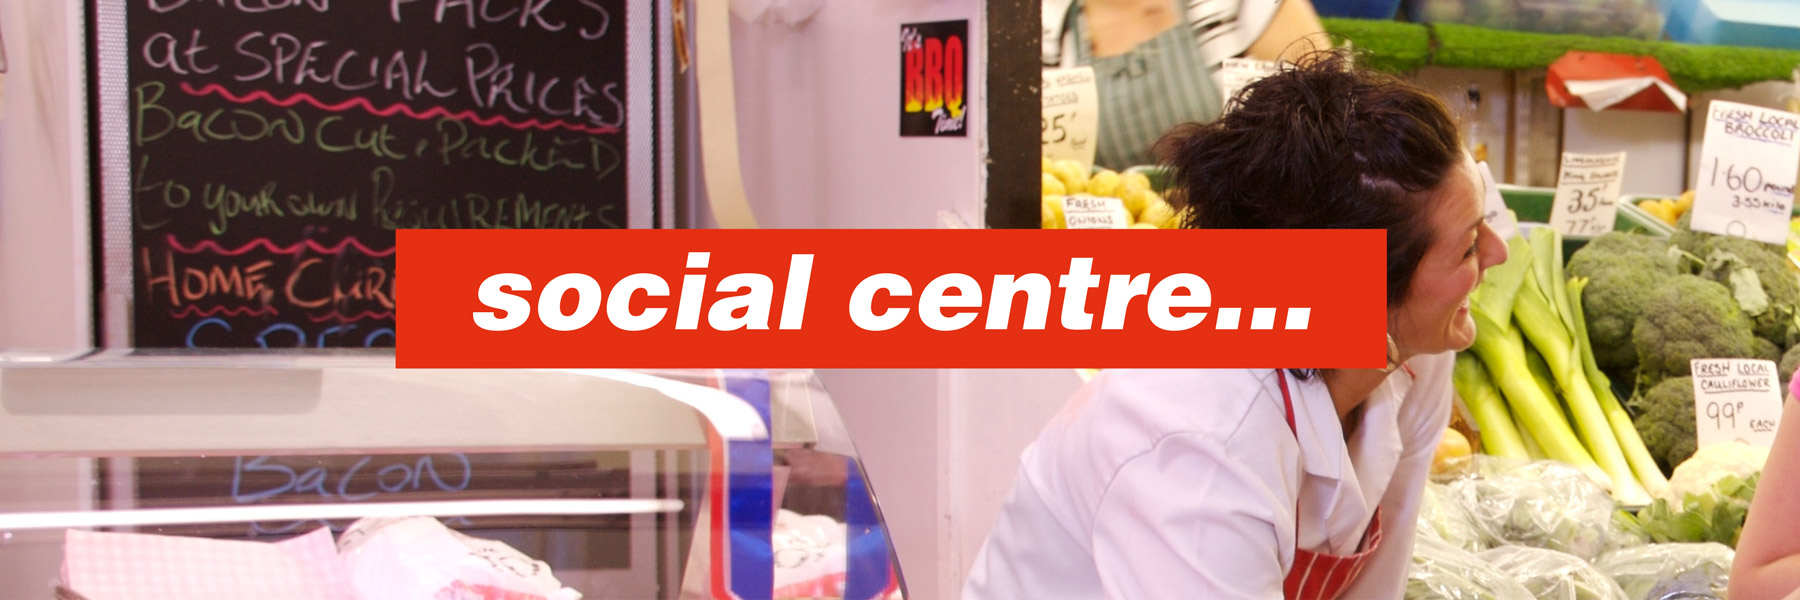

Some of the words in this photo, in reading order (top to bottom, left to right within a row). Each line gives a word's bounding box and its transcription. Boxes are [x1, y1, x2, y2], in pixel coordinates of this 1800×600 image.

[143, 29, 219, 75] at
[233, 31, 458, 101] SPECIAL
[465, 42, 624, 128] PRICES
[905, 35, 964, 118] BBQ
[1758, 111, 1800, 130] LOCAL
[1724, 121, 1795, 141] BROCCOLI
[1066, 198, 1106, 209] FRESH
[1068, 215, 1114, 226] ONIONS
[143, 247, 275, 307] HOME
[1695, 361, 1730, 376] FRESH
[1737, 363, 1771, 376] LOCAL
[1700, 378, 1771, 391] CAULIFLOWER
[1749, 419, 1776, 429] EACH
